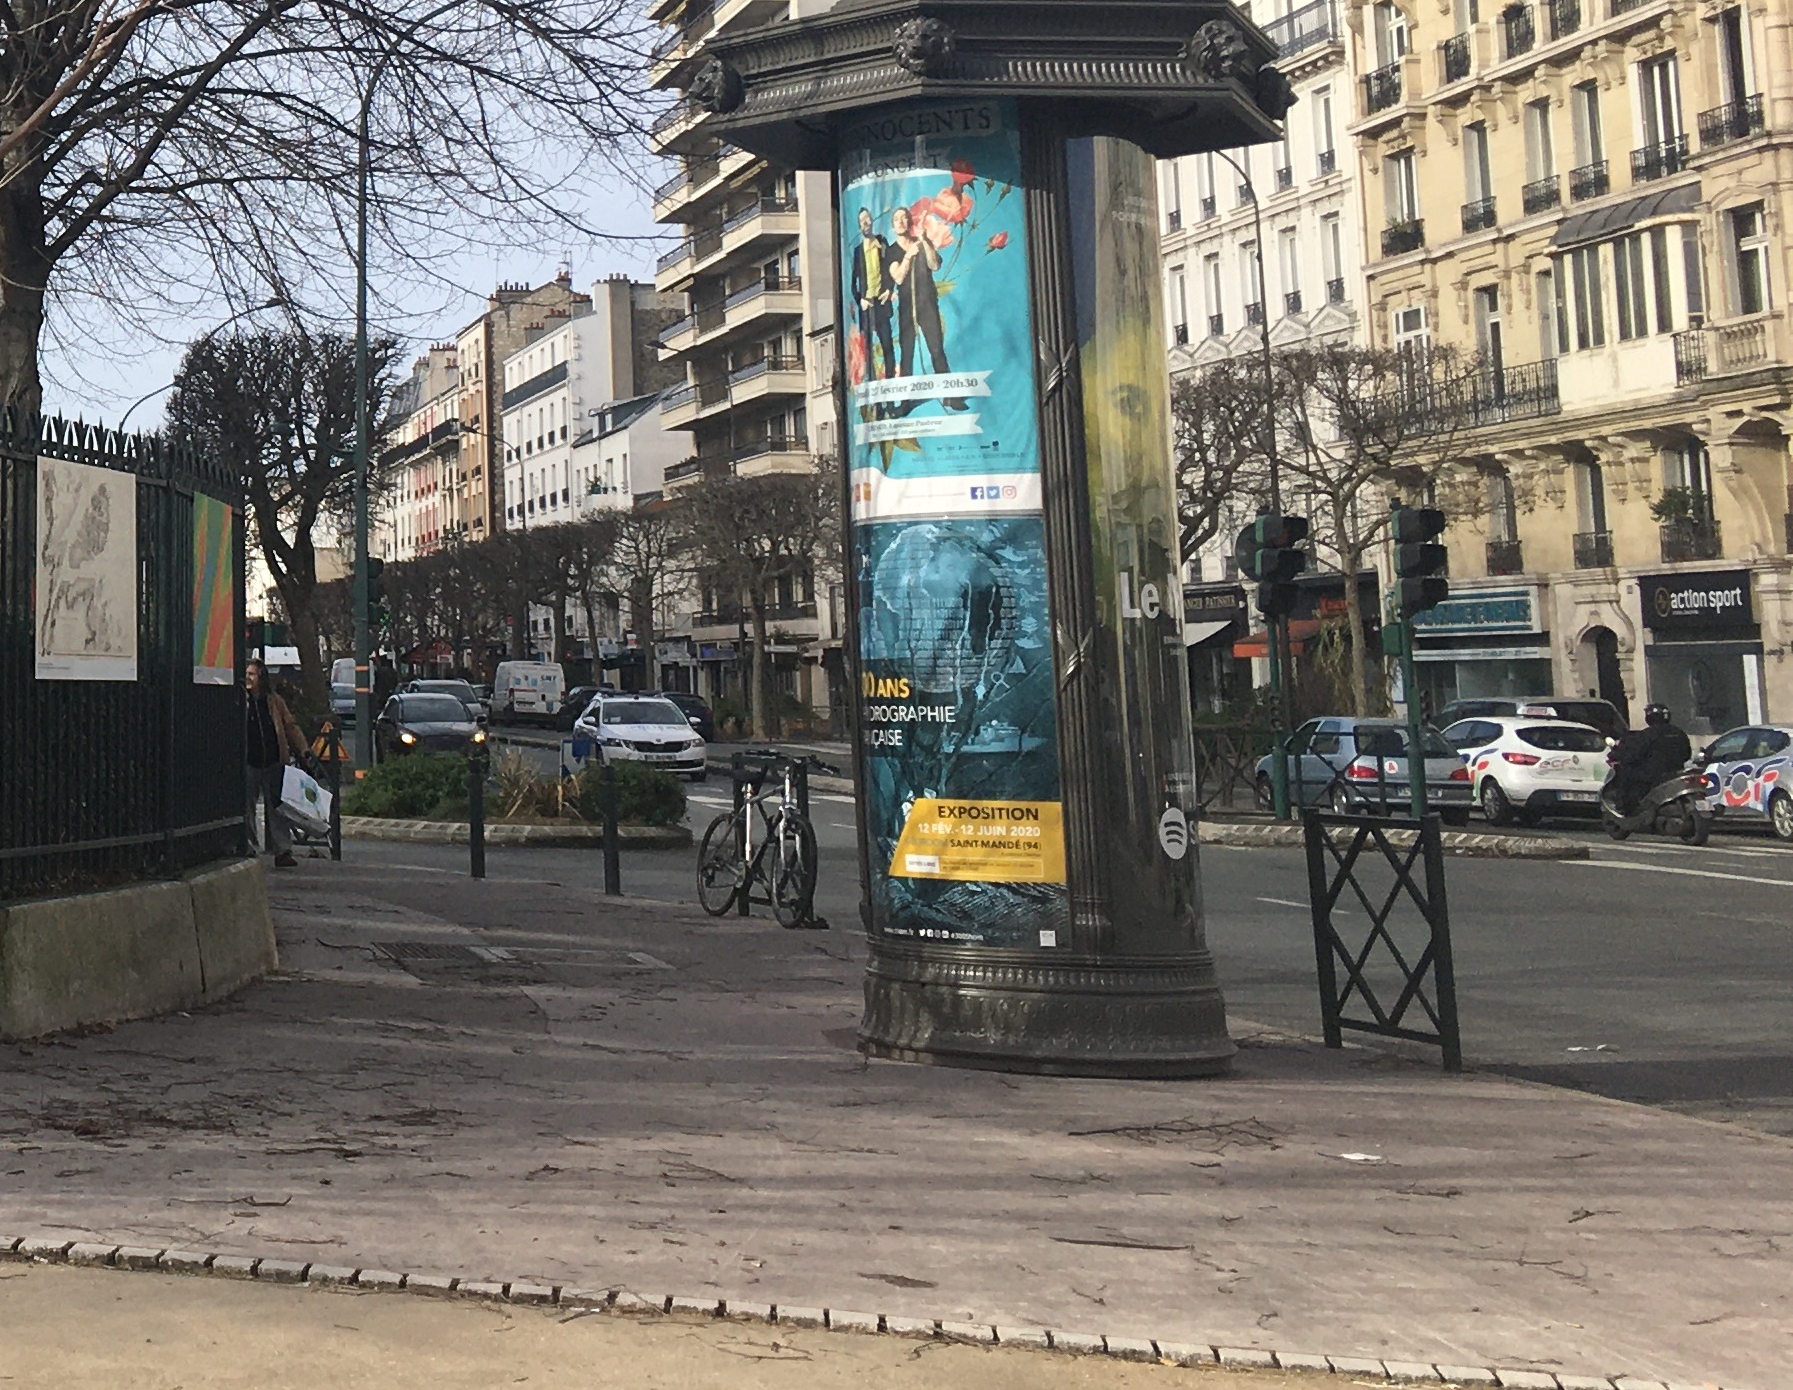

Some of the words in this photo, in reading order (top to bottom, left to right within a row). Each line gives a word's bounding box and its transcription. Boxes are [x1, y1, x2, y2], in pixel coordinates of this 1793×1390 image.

[910, 381, 934, 392] 2020
[943, 377, 979, 390] 20h30
[1670, 588, 1708, 609] action
[1708, 586, 1743, 615] sport
[876, 677, 911, 699] ANS
[937, 805, 1040, 821] EXPOSITION
[917, 823, 930, 834] 12
[931, 821, 955, 835] FÉV.
[960, 824, 974, 836] 12
[976, 825, 1007, 837] JUIN
[1010, 826, 1041, 838] 2020
[949, 838, 1022, 851] SAINT-MANDÉ
[1022, 840, 1043, 851] (94)
